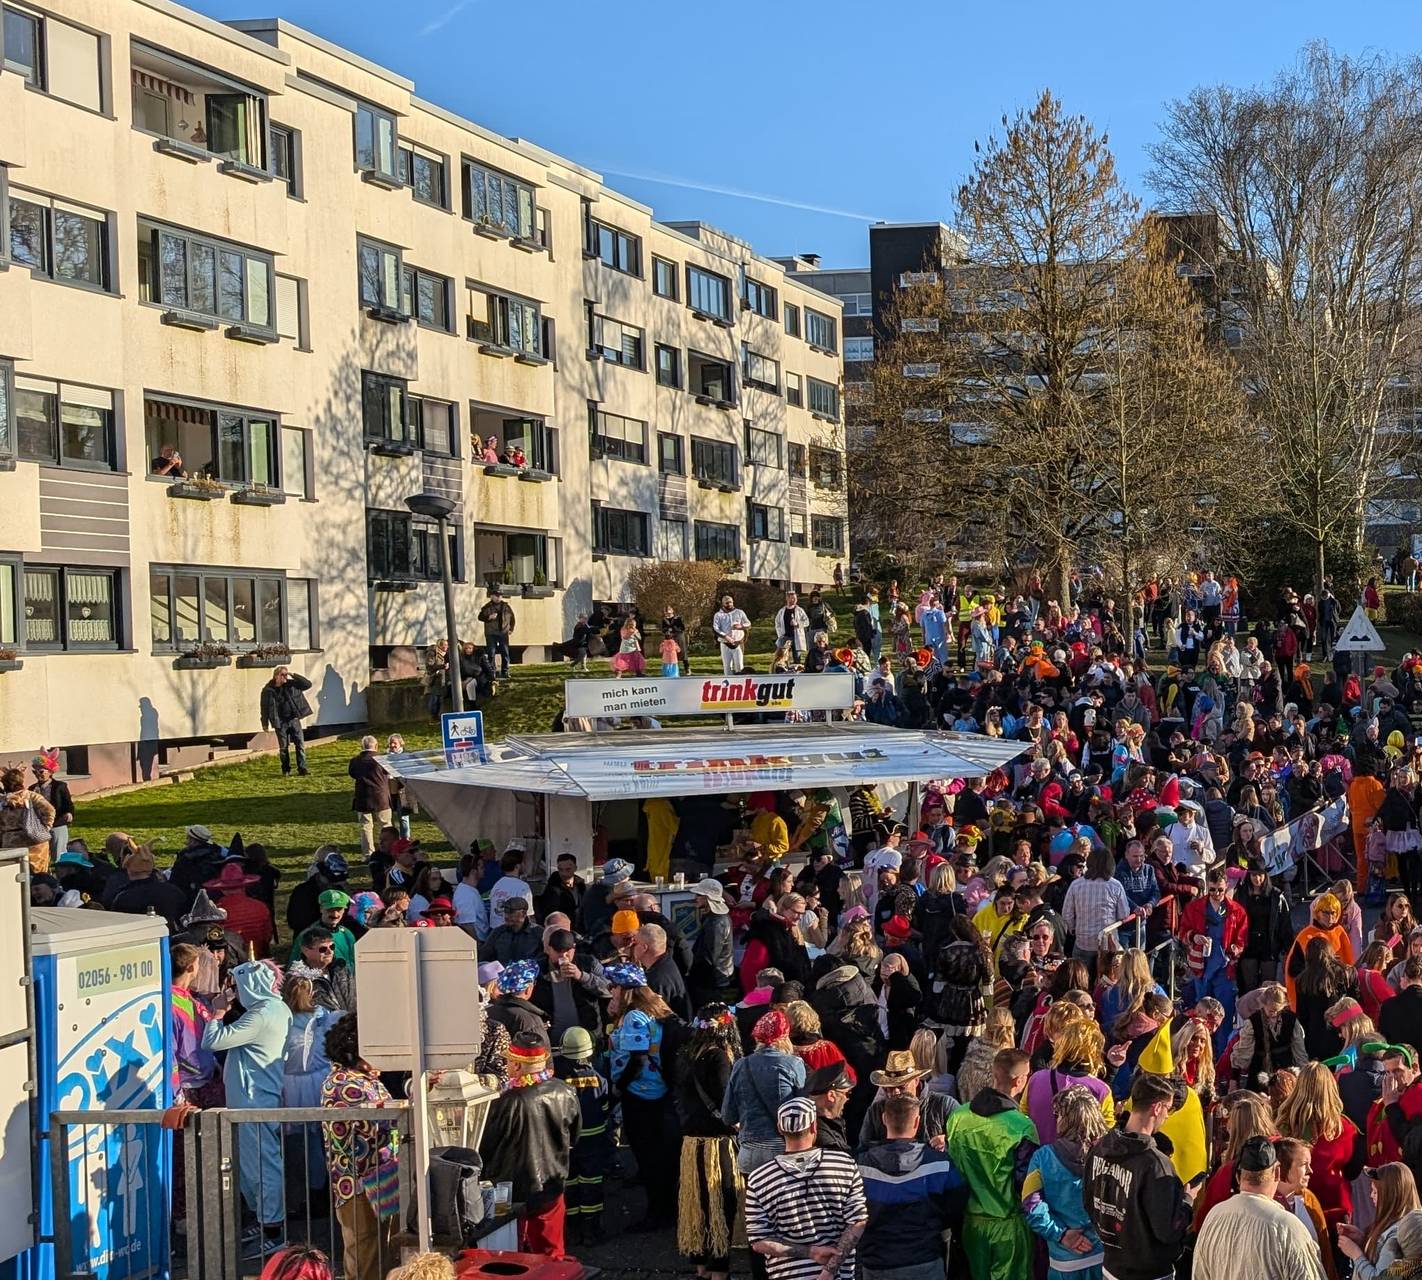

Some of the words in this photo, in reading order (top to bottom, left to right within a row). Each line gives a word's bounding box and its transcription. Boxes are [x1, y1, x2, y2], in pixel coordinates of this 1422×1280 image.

[602, 687, 629, 699] mich
[632, 684, 658, 696] kann
[604, 703, 627, 712] man
[630, 697, 666, 709] mieten
[702, 678, 795, 706] trinkgut
[79, 968, 111, 990] 02056
[120, 962, 138, 981] 981
[141, 960, 153, 978] 00
[1092, 1155, 1133, 1199] PEGADOR
